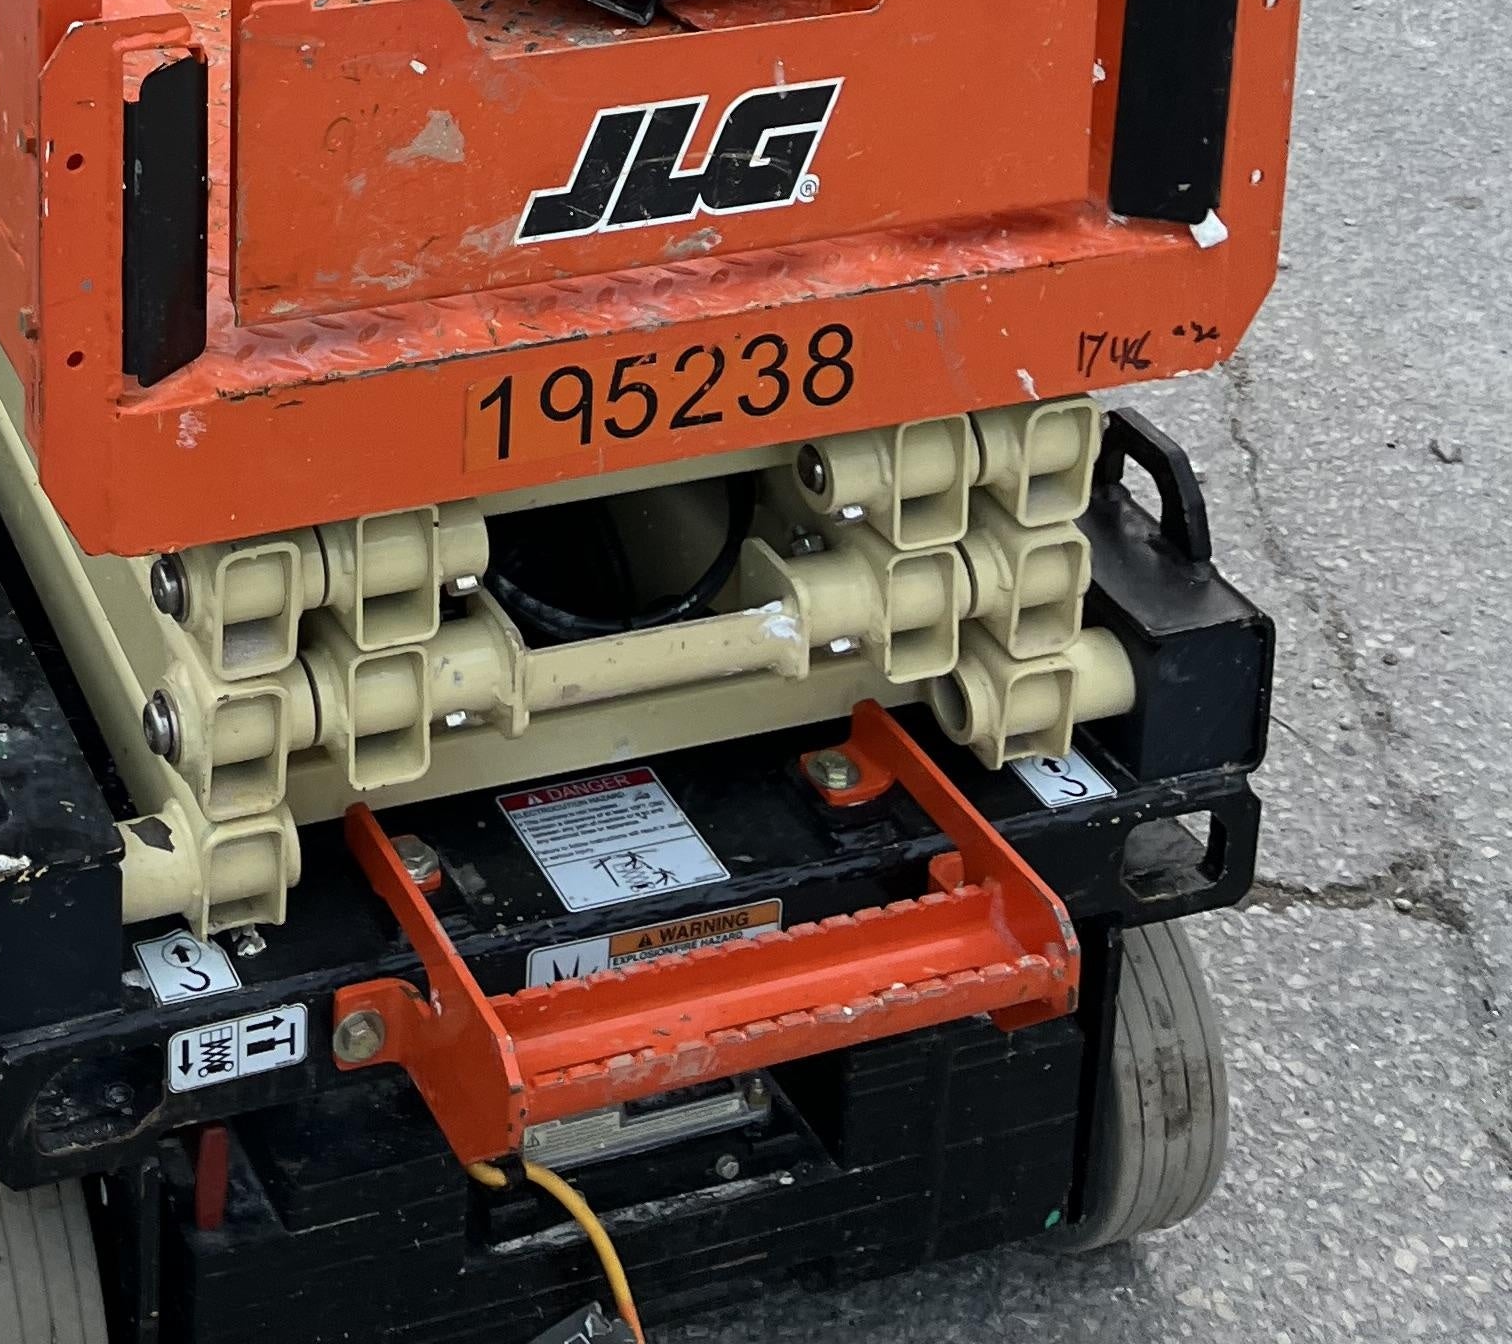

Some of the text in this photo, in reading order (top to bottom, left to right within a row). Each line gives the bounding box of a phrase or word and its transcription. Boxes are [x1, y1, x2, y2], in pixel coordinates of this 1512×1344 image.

[516, 77, 842, 244] JLG
[478, 323, 856, 460] 195238
[546, 774, 632, 801] DANGER
[658, 912, 750, 943] WARNING
[612, 930, 744, 967] EXPLOSION/FIRE HAZARD
